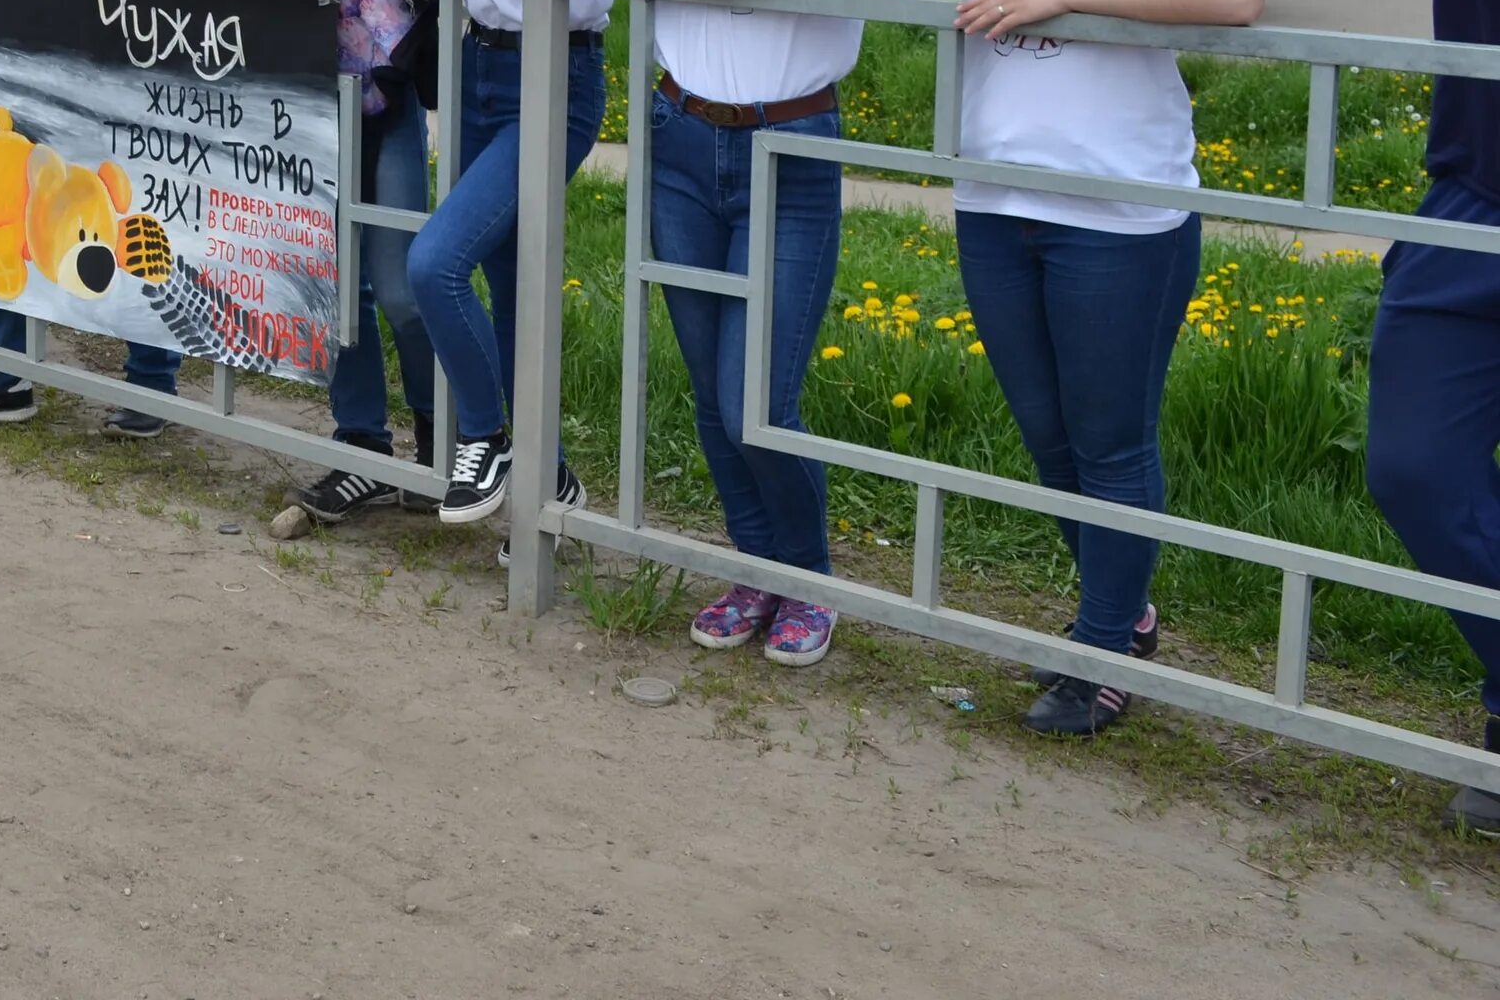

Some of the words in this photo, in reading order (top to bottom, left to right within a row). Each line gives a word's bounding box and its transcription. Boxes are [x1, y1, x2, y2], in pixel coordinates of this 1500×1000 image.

[144, 82, 243, 129] ЖИЗНЬ
[271, 98, 292, 140] В
[103, 121, 211, 175] ТВОИХ
[141, 173, 202, 232] ЗАХ!
[210, 188, 273, 218] ПРОВЕРЬ
[204, 237, 235, 263] ЭТО
[241, 246, 301, 275] МОЖЕТ
[208, 210, 217, 229] В
[222, 212, 314, 249] СЛЕДУЮЩИЙ
[318, 233, 335, 256] РАЗ
[196, 263, 265, 305] ЖИВОЙ
[213, 299, 329, 372] ЧЕЛОВЕК
